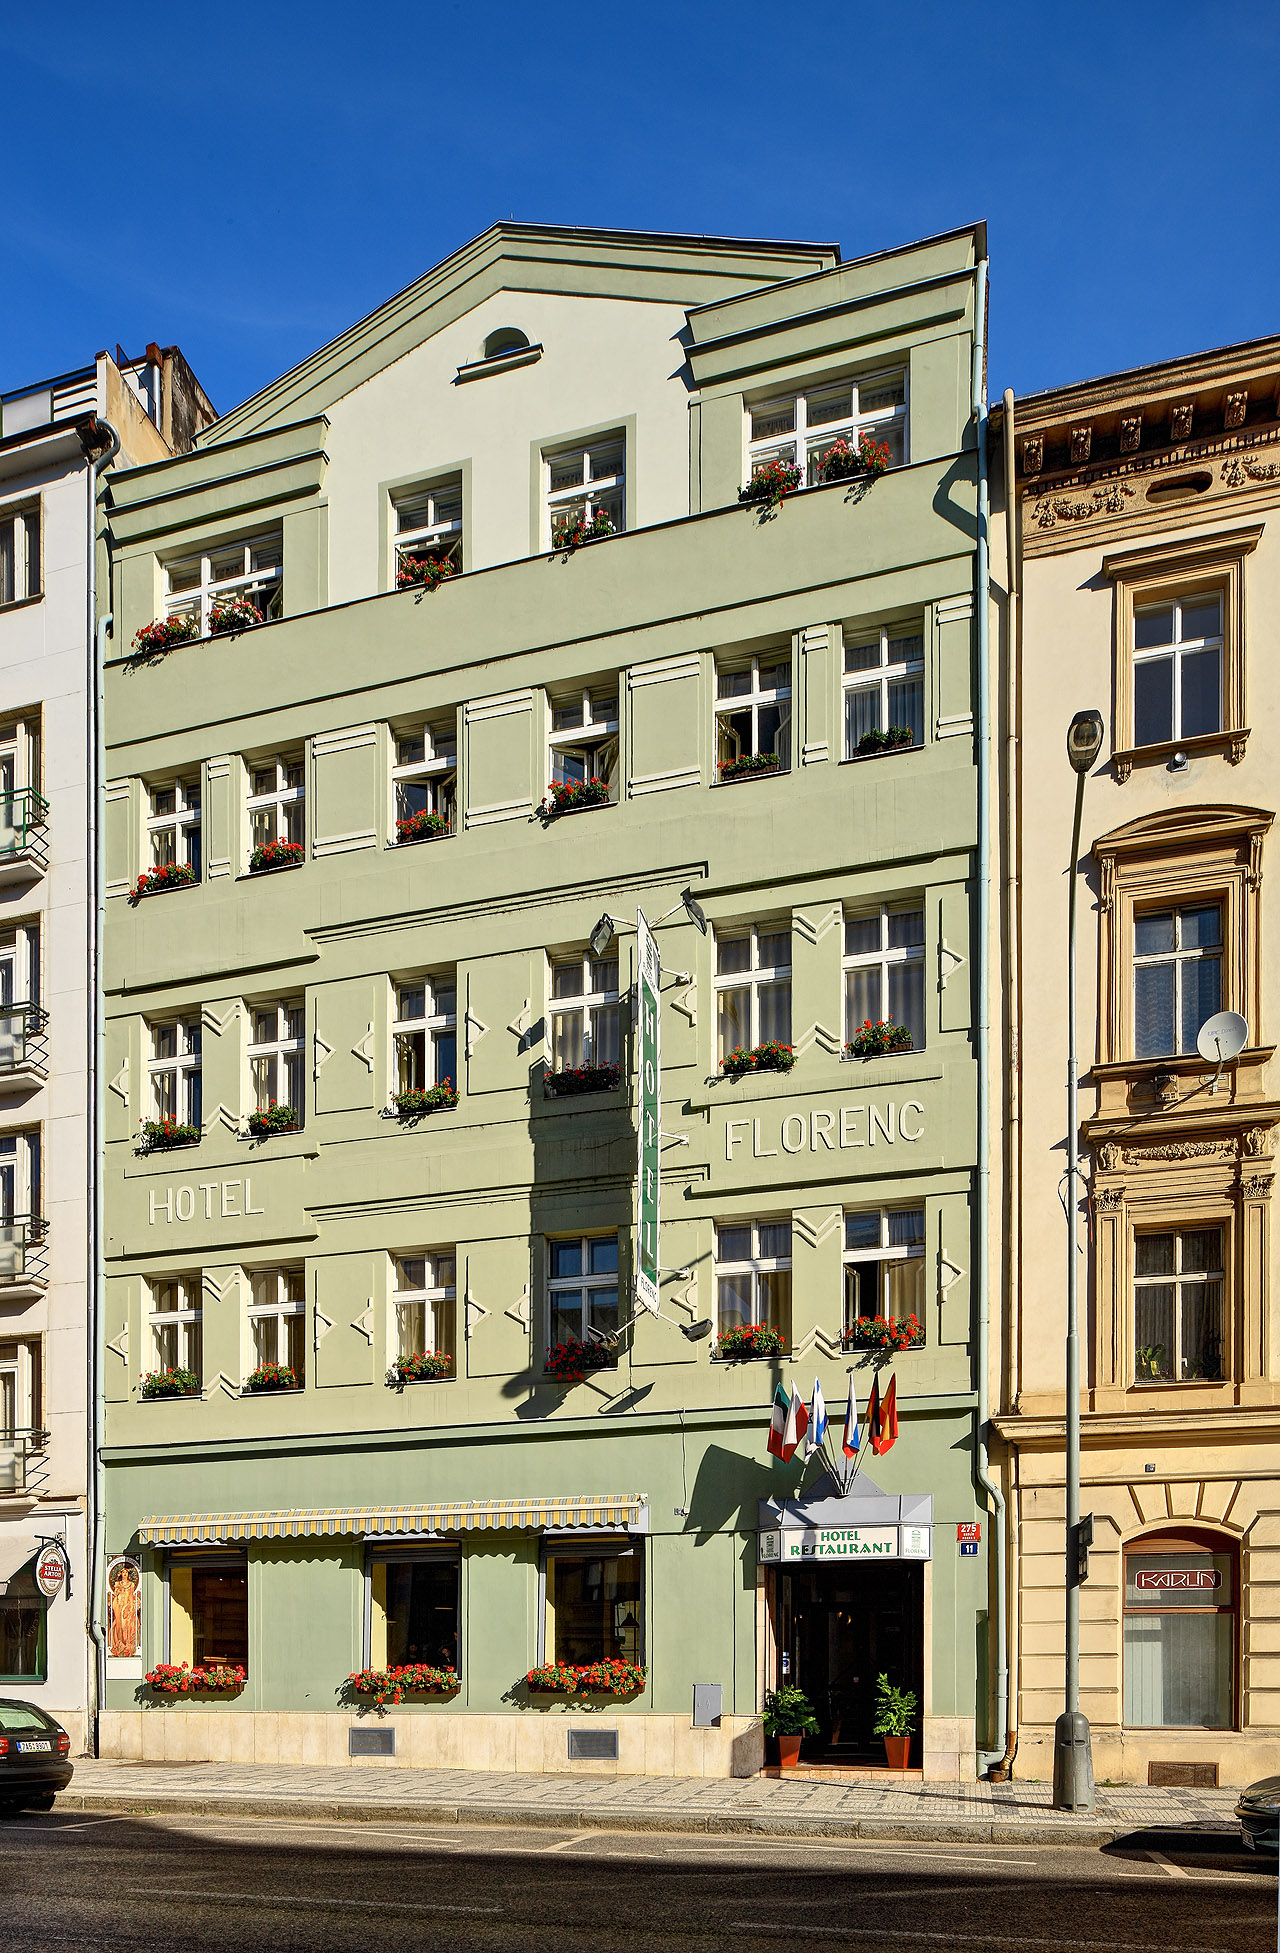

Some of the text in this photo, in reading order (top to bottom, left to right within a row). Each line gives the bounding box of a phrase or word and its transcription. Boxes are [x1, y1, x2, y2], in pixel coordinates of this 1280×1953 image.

[645, 1001, 655, 1259] HOTEL
[725, 1100, 925, 1161] FLORENC
[149, 1178, 264, 1225] HOTEL
[961, 1524, 977, 1532] 275
[821, 1531, 861, 1541] HOTEL
[791, 1543, 892, 1555] RESTAURANT
[966, 1544, 974, 1553] 11
